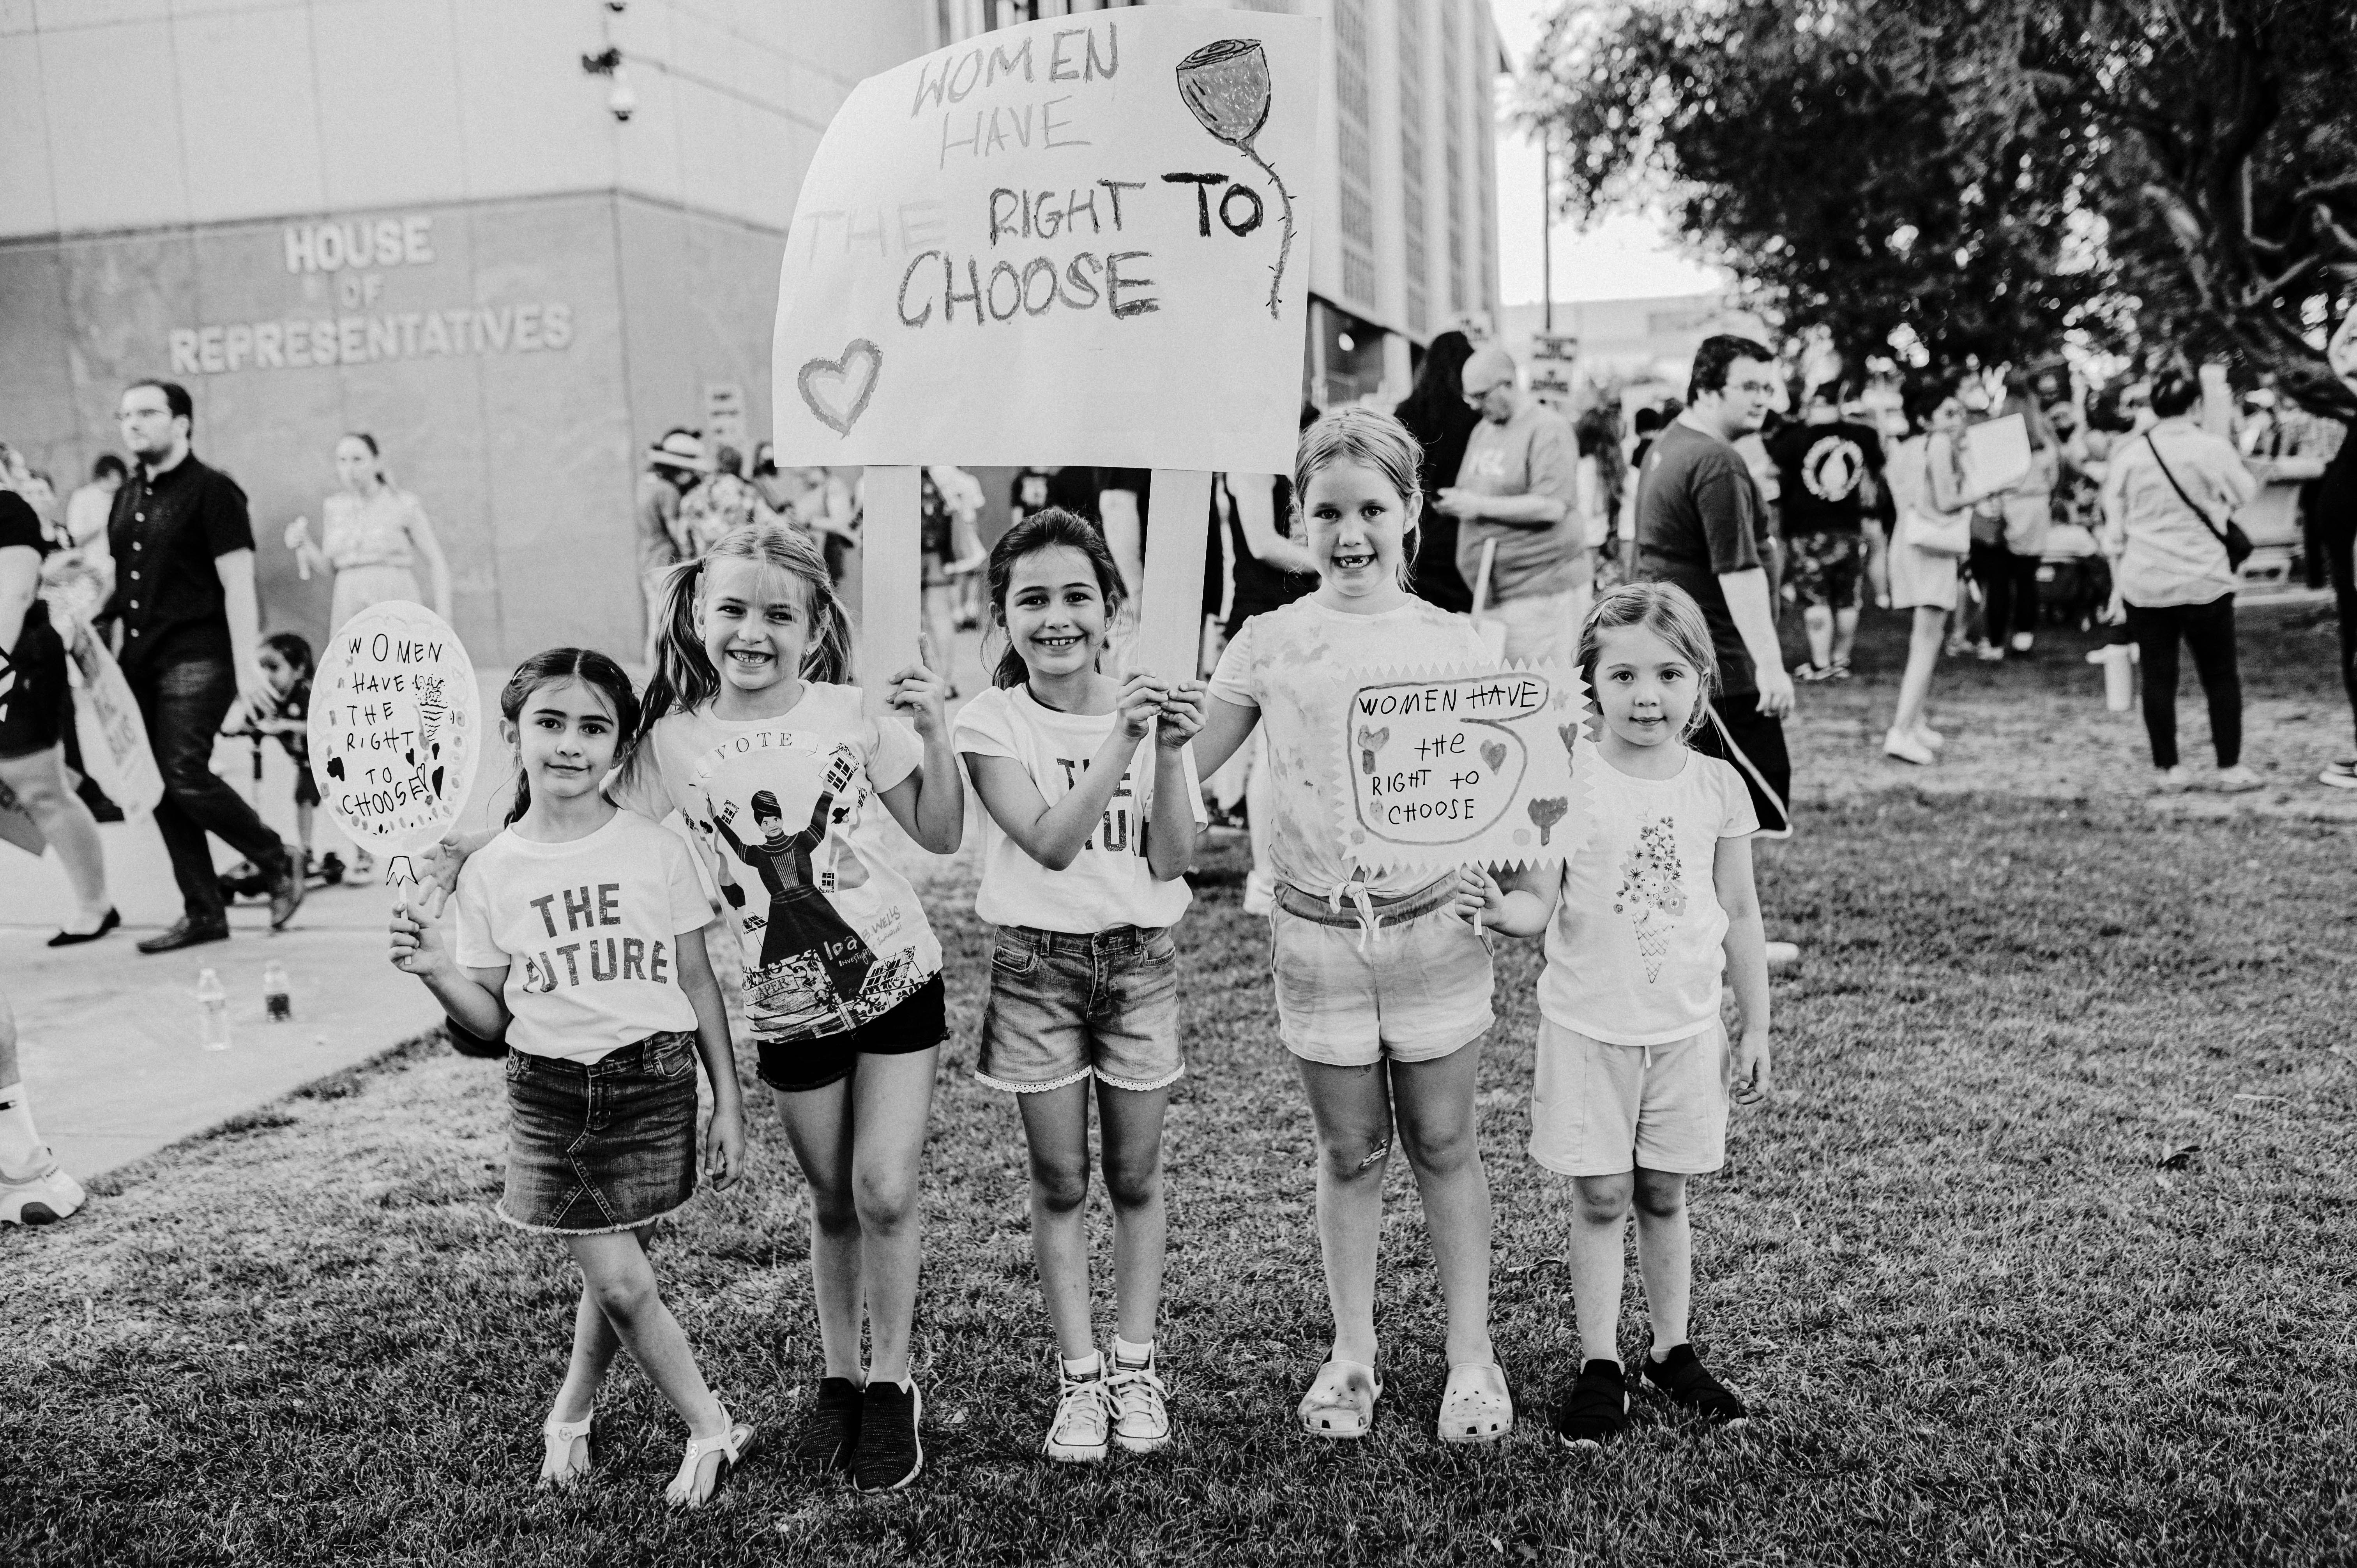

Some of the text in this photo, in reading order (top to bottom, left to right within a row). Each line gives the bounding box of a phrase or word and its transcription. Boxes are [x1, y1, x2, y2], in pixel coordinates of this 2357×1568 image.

[911, 22, 1118, 117] WOMEN
[938, 95, 1092, 169] HAVE
[802, 172, 1263, 270] THE RIGHT TO
[283, 215, 435, 274] HOUSE
[340, 274, 385, 309] OF
[897, 249, 1160, 328] CHOOSE
[168, 302, 573, 375] REPRESENTATIVES
[349, 633, 442, 663] WOMEN
[352, 672, 405, 694] HAVE
[1359, 681, 1538, 716] WOMEN HAVE
[346, 702, 394, 726] THE
[347, 727, 414, 754] RIGHT
[714, 732, 792, 759] VOTE
[365, 766, 392, 785] TO
[1372, 769, 1431, 796] RIGHT
[1388, 798, 1474, 825] CHOOSE
[529, 883, 621, 938] THE
[871, 906, 901, 934] WELLS
